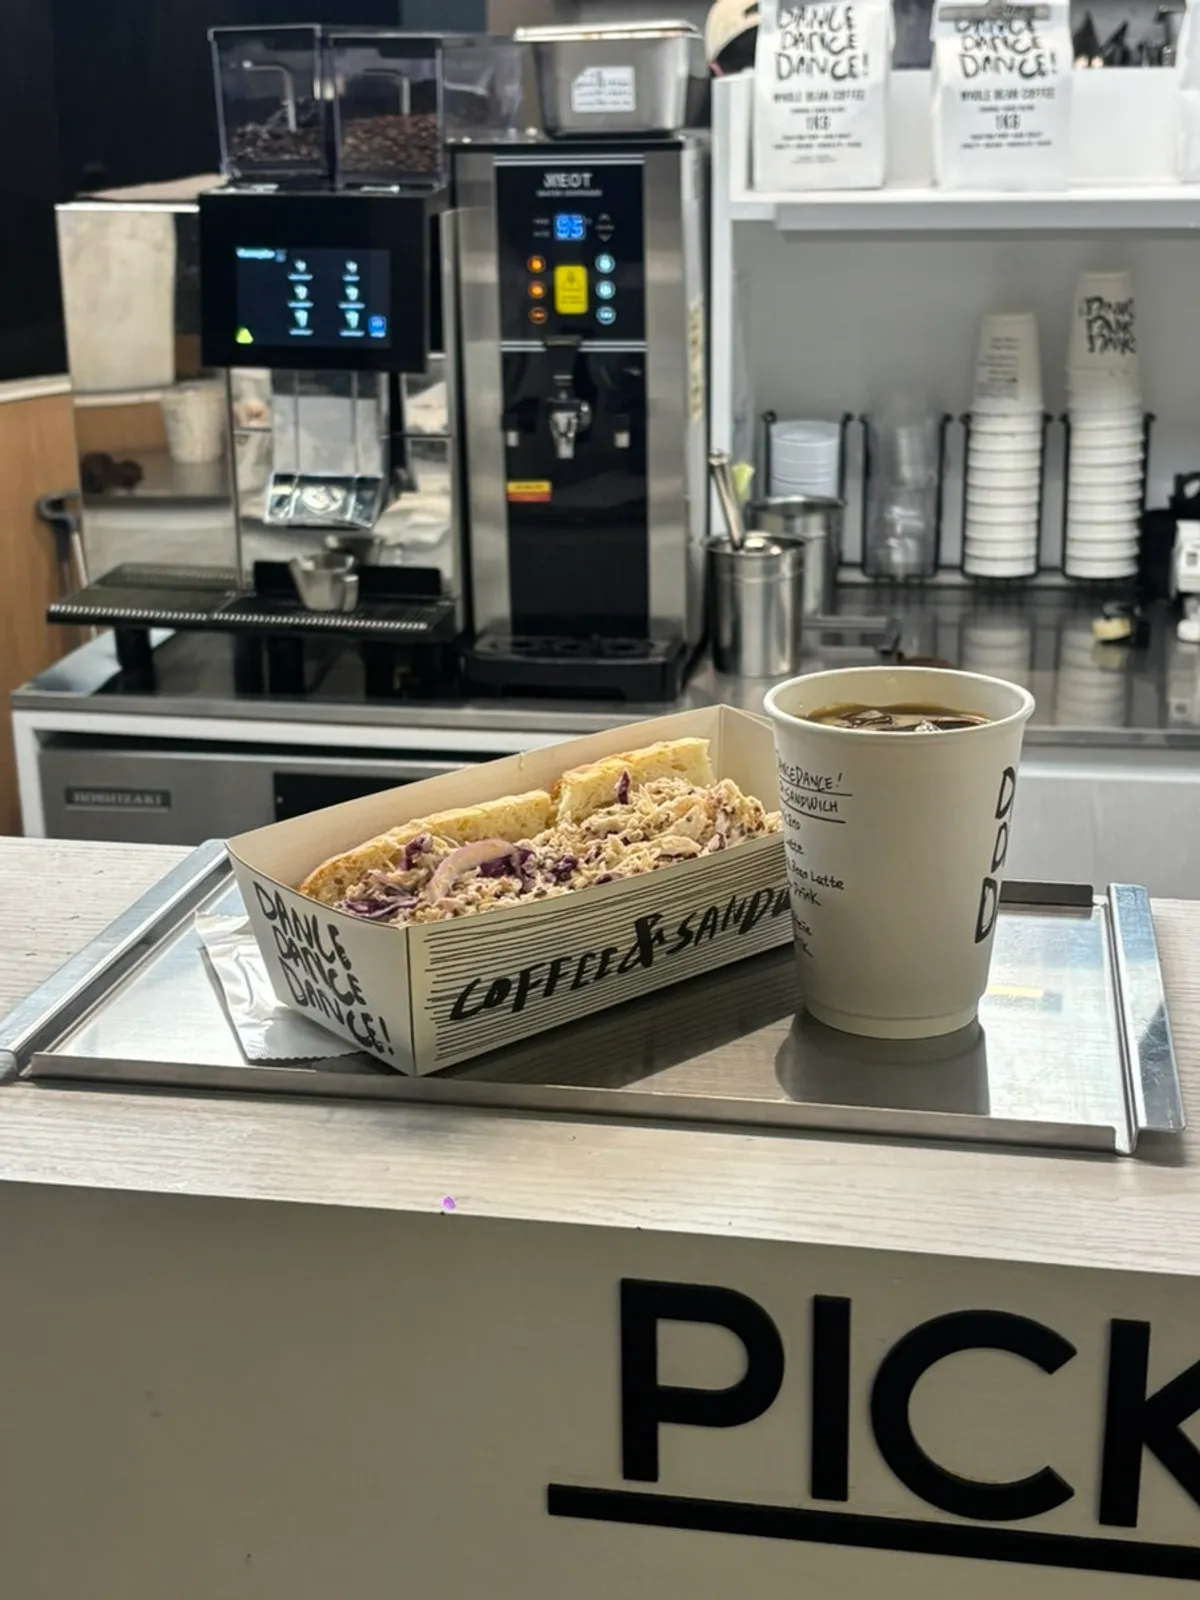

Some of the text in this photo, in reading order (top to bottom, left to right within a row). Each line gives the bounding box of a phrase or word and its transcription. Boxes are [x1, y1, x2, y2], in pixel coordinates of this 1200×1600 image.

[781, 31, 856, 54] DANCE
[962, 35, 1041, 54] DANCE
[776, 53, 868, 80] DANCE!
[960, 53, 1056, 78] DANCE!
[810, 870, 844, 890] Latte
[253, 881, 352, 970] DANCE
[272, 925, 367, 1006] DANCE
[278, 955, 394, 1056] DANCE!
[620, 1277, 1200, 1528] PICK
